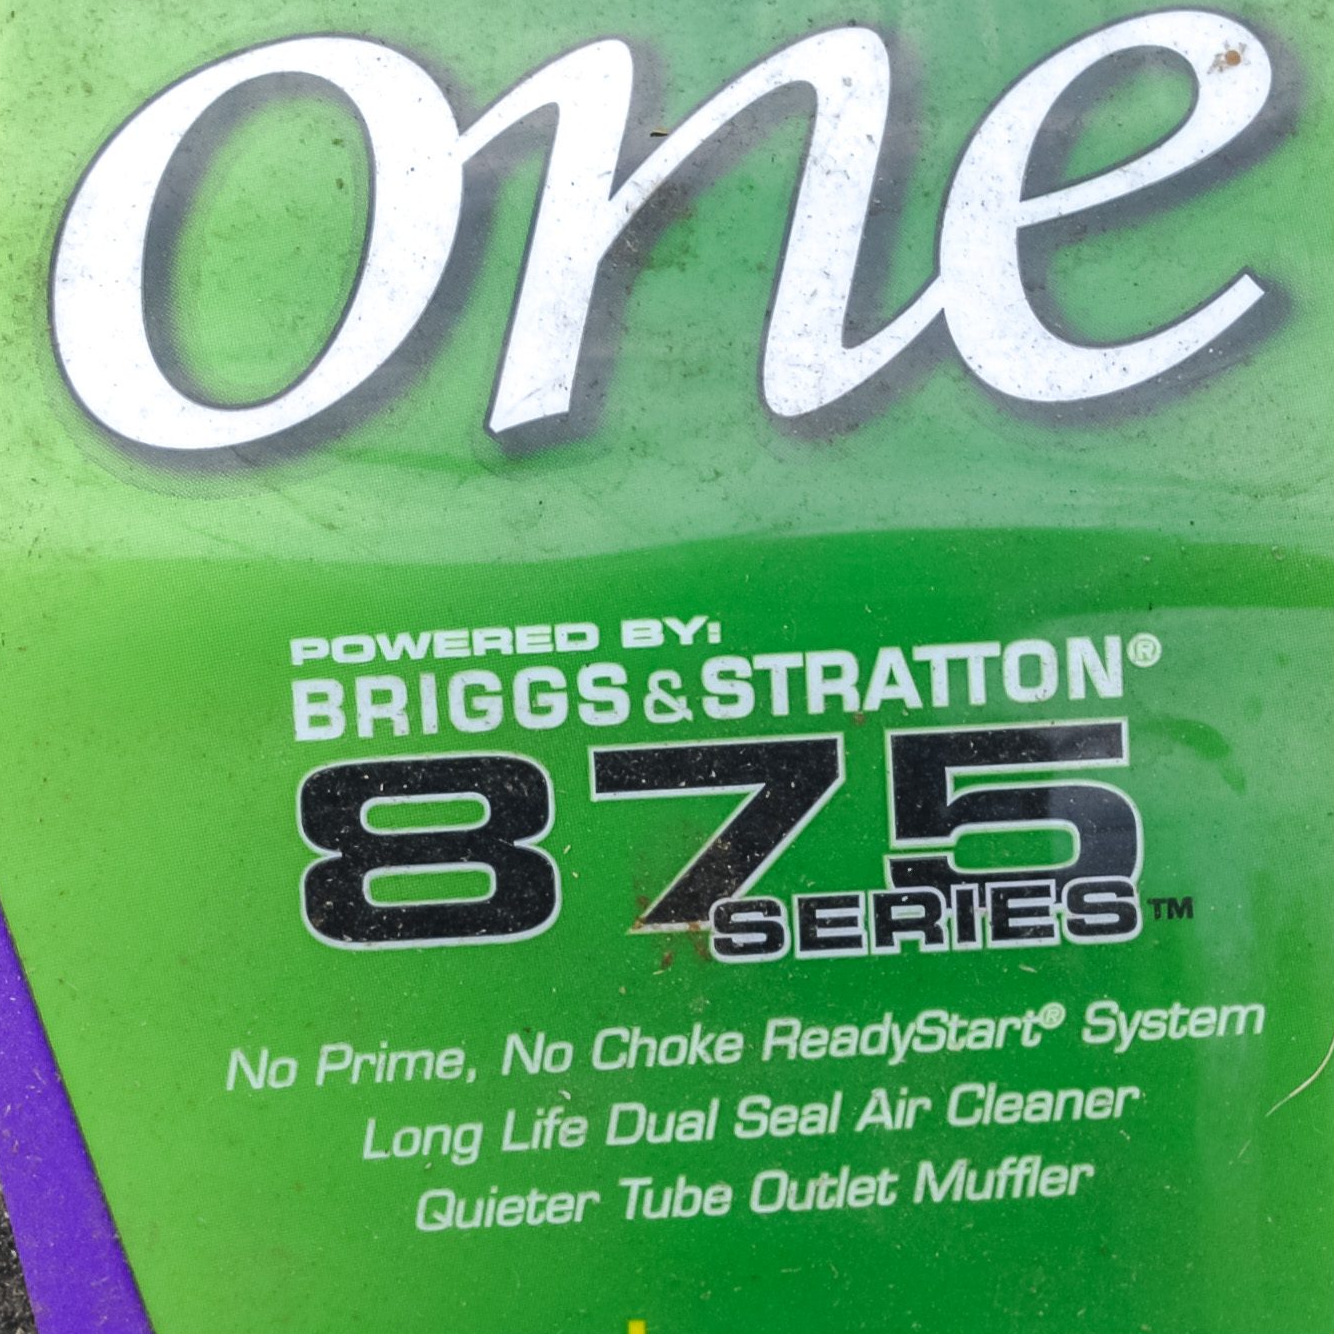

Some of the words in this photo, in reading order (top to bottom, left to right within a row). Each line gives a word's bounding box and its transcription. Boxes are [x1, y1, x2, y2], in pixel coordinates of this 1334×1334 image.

[51, 8, 1273, 450] one
[289, 621, 600, 666] POWERED
[620, 615, 722, 649] BY:
[296, 717, 1144, 951] 875
[225, 1046, 298, 1092] No
[315, 1040, 478, 1088] Prime,
[500, 1030, 575, 1077] No
[591, 1021, 745, 1072] Choke
[1081, 999, 1266, 1054] System
[362, 1116, 484, 1167] Long
[500, 1105, 589, 1153] Life
[604, 1096, 720, 1147] Dual
[733, 1089, 843, 1139] Seal
[854, 1085, 933, 1132] Air
[945, 1081, 1141, 1128] Cleaner
[414, 1184, 601, 1233] Quieter
[618, 1174, 733, 1221] Tube
[748, 1164, 899, 1214] Outlet
[912, 1154, 1096, 1205] Muffler
